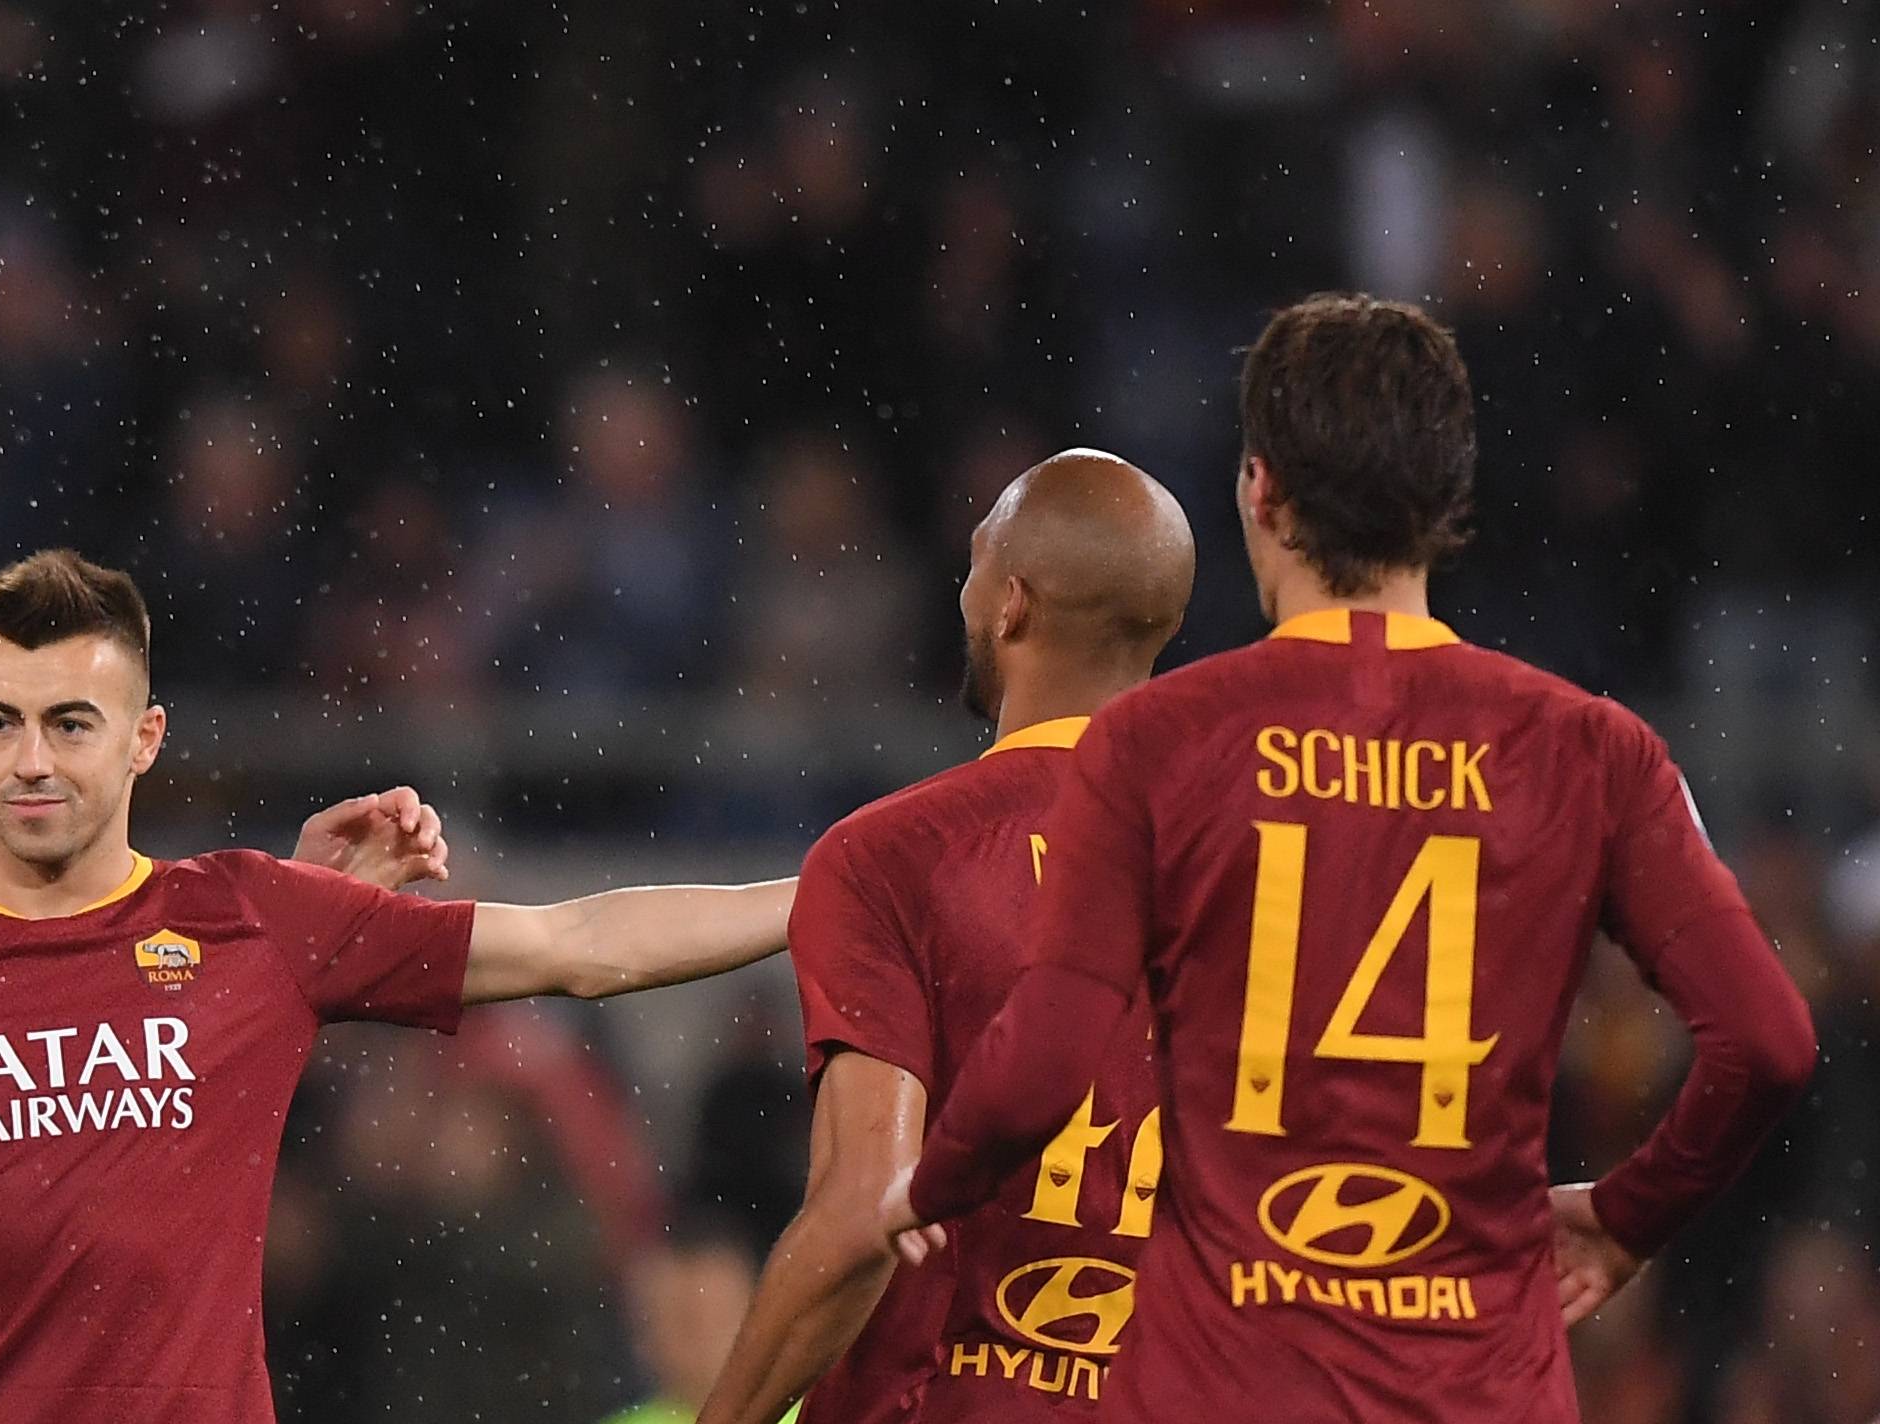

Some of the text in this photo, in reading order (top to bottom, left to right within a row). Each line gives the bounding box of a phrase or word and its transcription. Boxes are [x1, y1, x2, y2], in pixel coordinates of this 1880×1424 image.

[1256, 725, 1493, 812] SCHICK
[148, 970, 194, 983] ROMA
[1223, 820, 1499, 1150] 14
[1231, 1260, 1477, 1320] HYUNDAI
[950, 1343, 1110, 1400] HYUN
